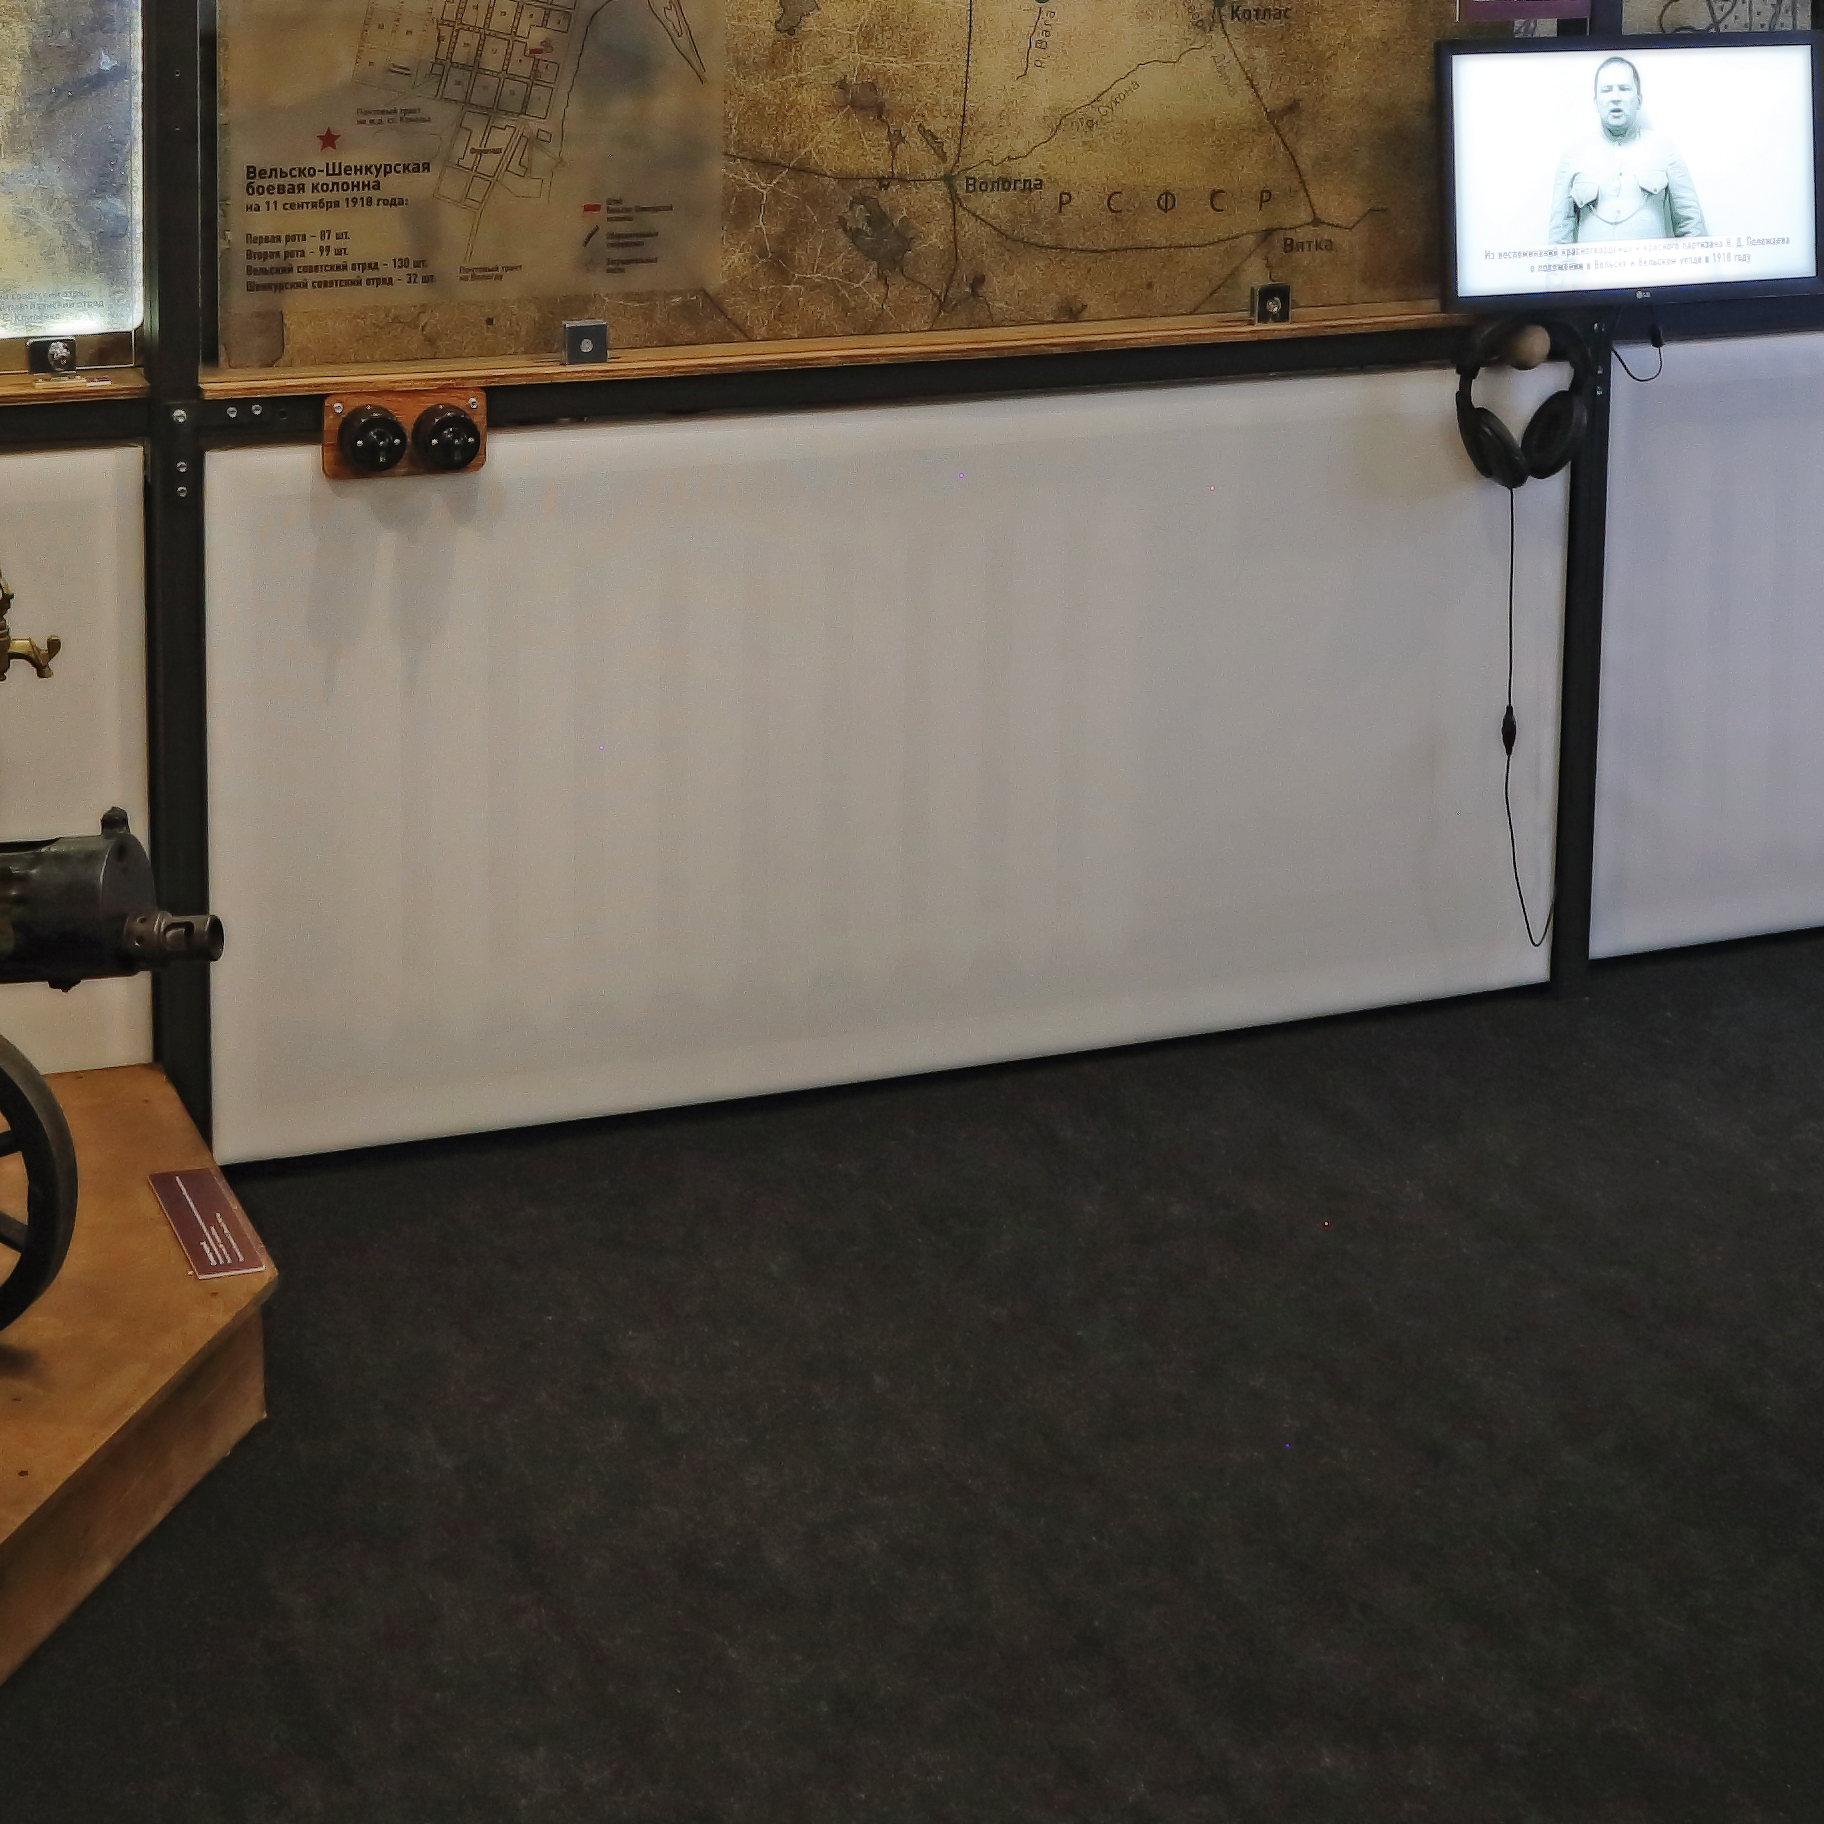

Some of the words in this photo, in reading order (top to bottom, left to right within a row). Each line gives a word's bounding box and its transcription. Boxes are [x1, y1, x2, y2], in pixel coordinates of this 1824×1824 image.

[1230, 4, 1290, 23] Котлас
[246, 162, 431, 180] Вельско-Шенкурская
[246, 179, 306, 196] боевая
[312, 179, 380, 194] колонна
[246, 203, 260, 212] на
[266, 200, 278, 212] 11
[282, 198, 340, 212] сентября
[345, 196, 372, 208] 1918
[376, 196, 409, 208] года:
[1282, 237, 1334, 255] Вятка
